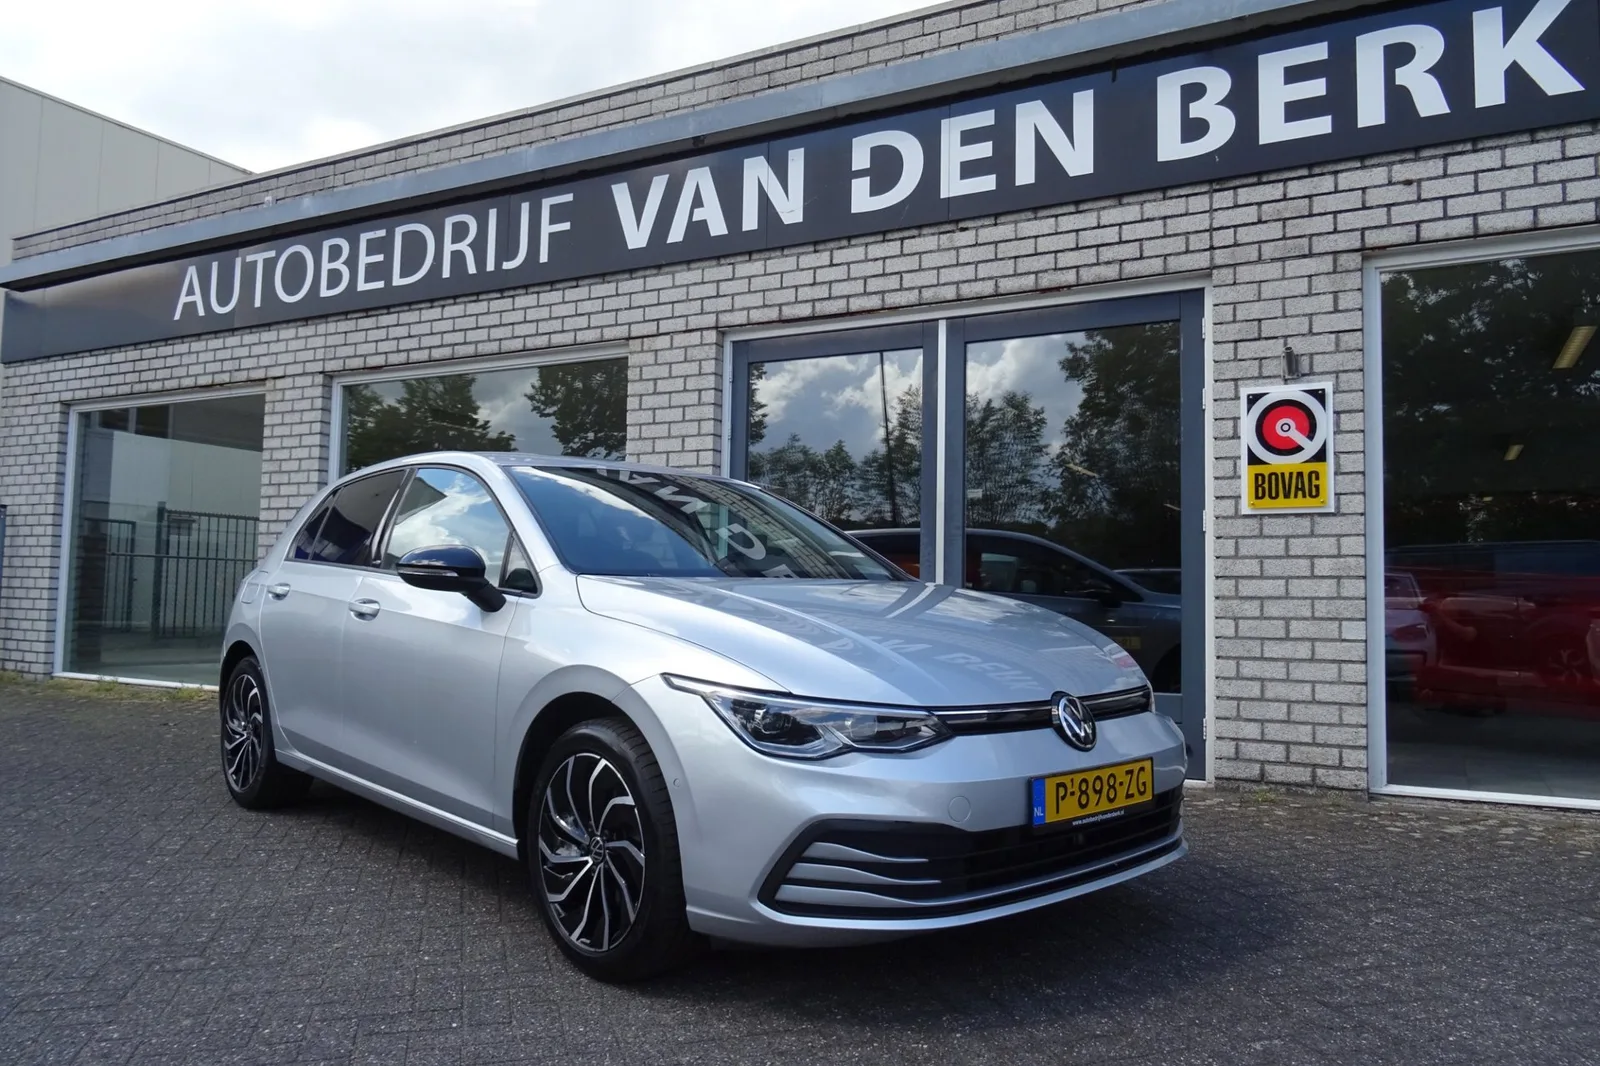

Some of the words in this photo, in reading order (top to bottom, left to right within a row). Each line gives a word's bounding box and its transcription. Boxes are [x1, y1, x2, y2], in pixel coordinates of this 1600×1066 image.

[173, 192, 574, 321] AUTOBEDRIJF
[611, 147, 805, 250] VAN
[850, 89, 1095, 214] DEN
[1157, 0, 1586, 162] BERK
[1254, 470, 1320, 500] BOVAG
[1033, 807, 1044, 817] NL
